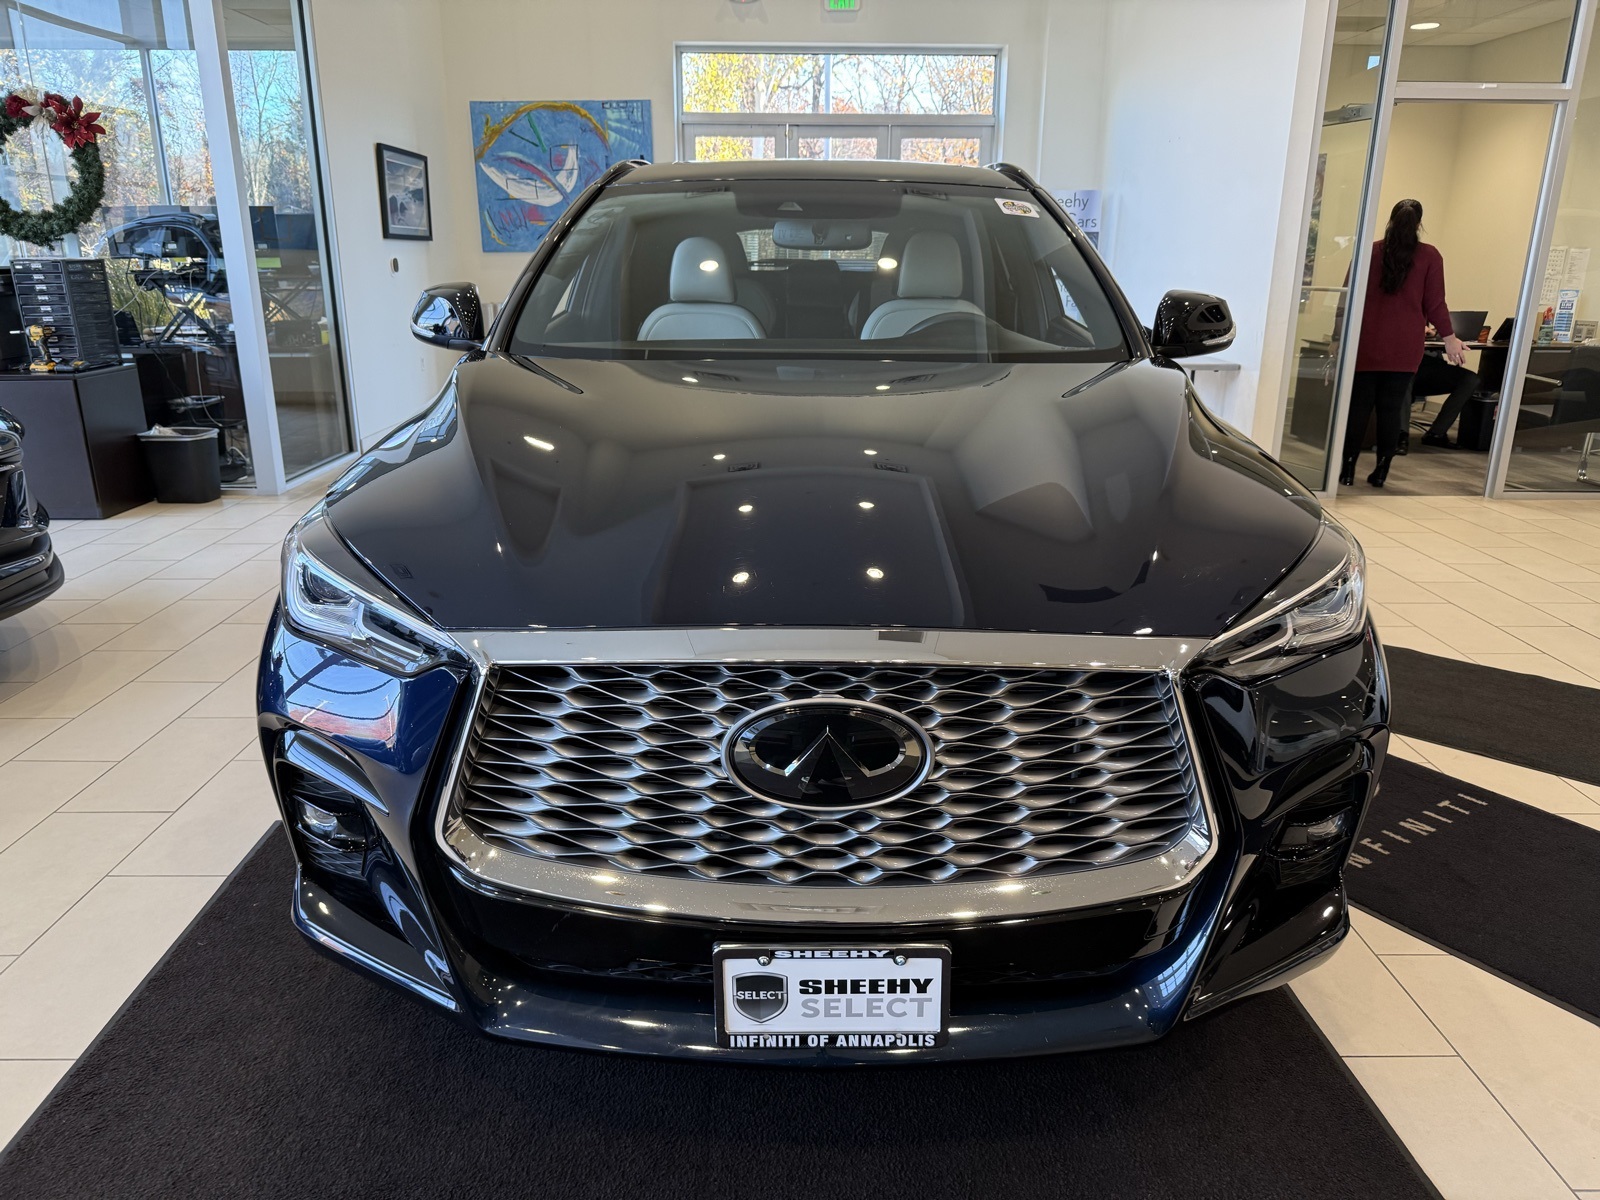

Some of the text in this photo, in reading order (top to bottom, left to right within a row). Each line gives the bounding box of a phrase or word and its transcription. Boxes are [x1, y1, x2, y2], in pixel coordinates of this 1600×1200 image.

[1069, 212, 1097, 228] ars
[774, 950, 890, 958] SHEEHY
[798, 978, 935, 995] SHEEHY
[736, 990, 784, 1000] SELECT
[800, 997, 933, 1018] SELECT
[729, 1034, 936, 1048] INFINITI OF ANNAPOLIS
